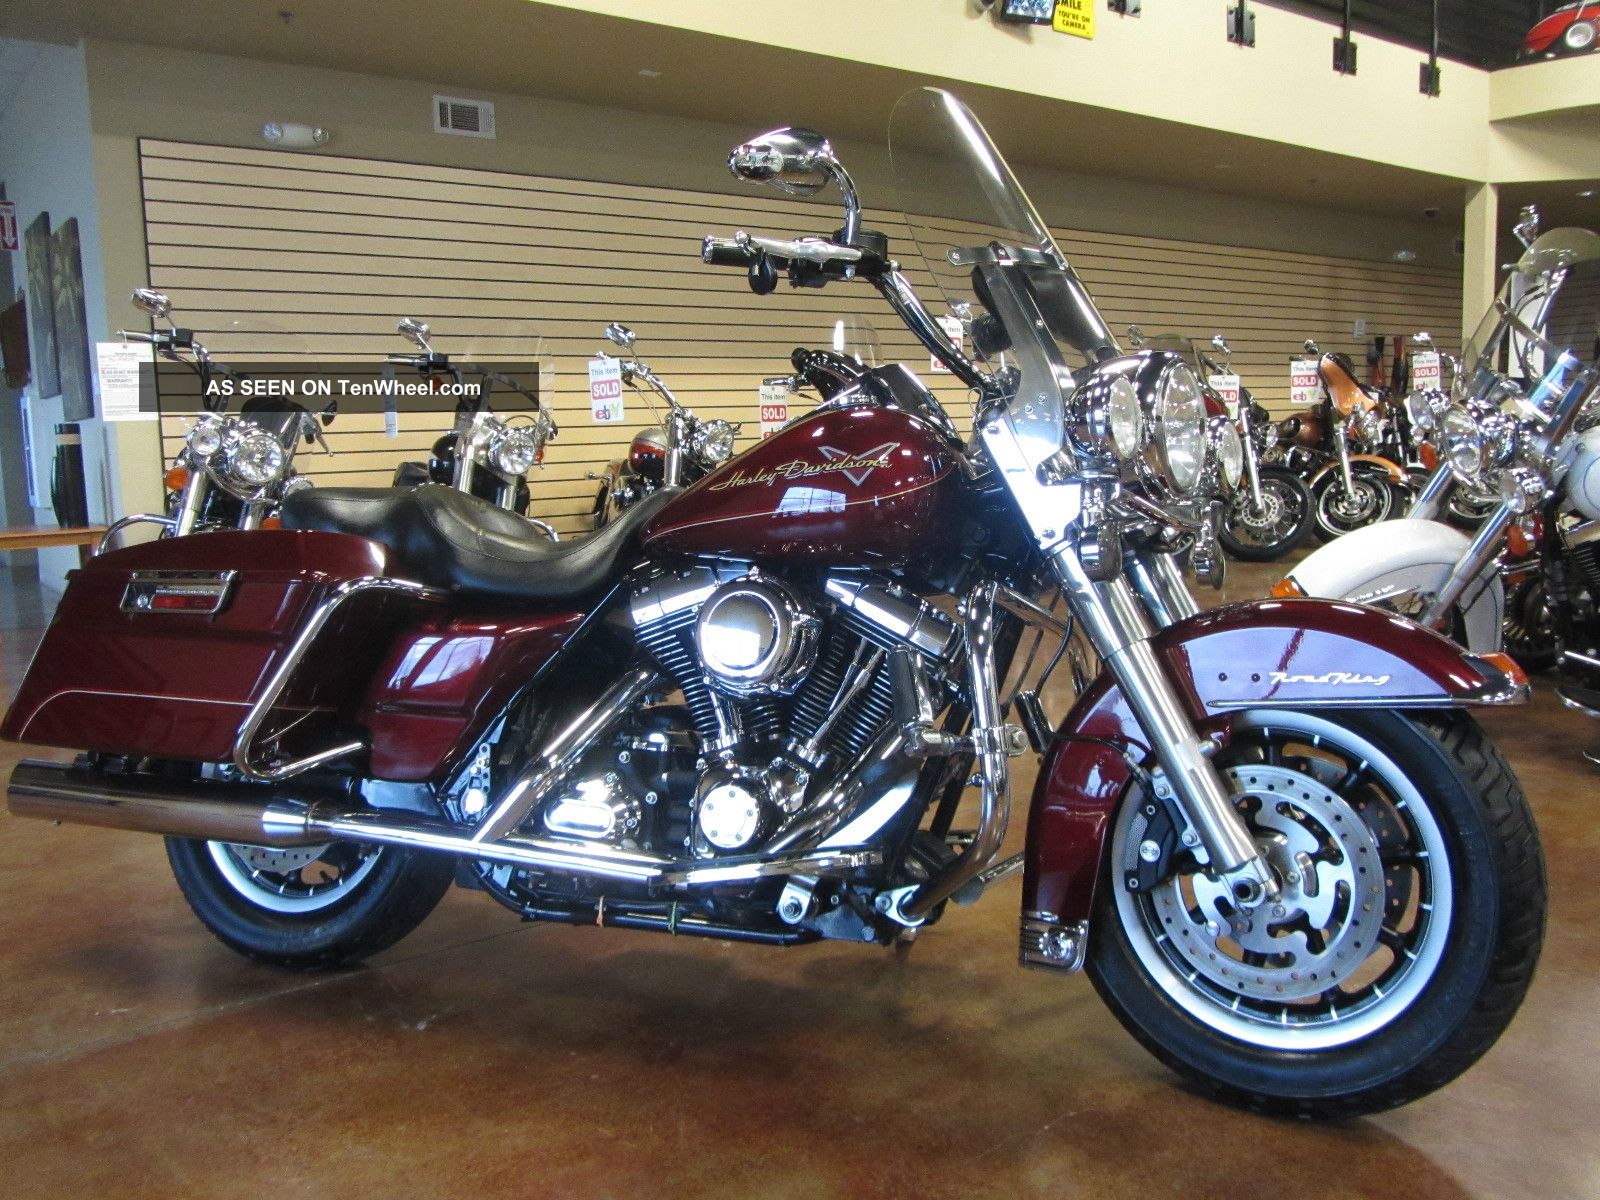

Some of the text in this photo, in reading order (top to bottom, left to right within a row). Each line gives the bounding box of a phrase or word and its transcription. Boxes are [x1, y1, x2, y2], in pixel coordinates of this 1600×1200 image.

[1058, 10, 1090, 23] YOU'RE ON
[1062, 19, 1086, 30] CAMERA
[591, 367, 618, 376] This item
[1415, 367, 1437, 377] SOLD
[1293, 376, 1317, 386] SOLD
[592, 382, 619, 397] SOLD
[1217, 391, 1237, 401] LD
[762, 407, 786, 420] SOLD
[708, 455, 882, 491] Harley-Davidson
